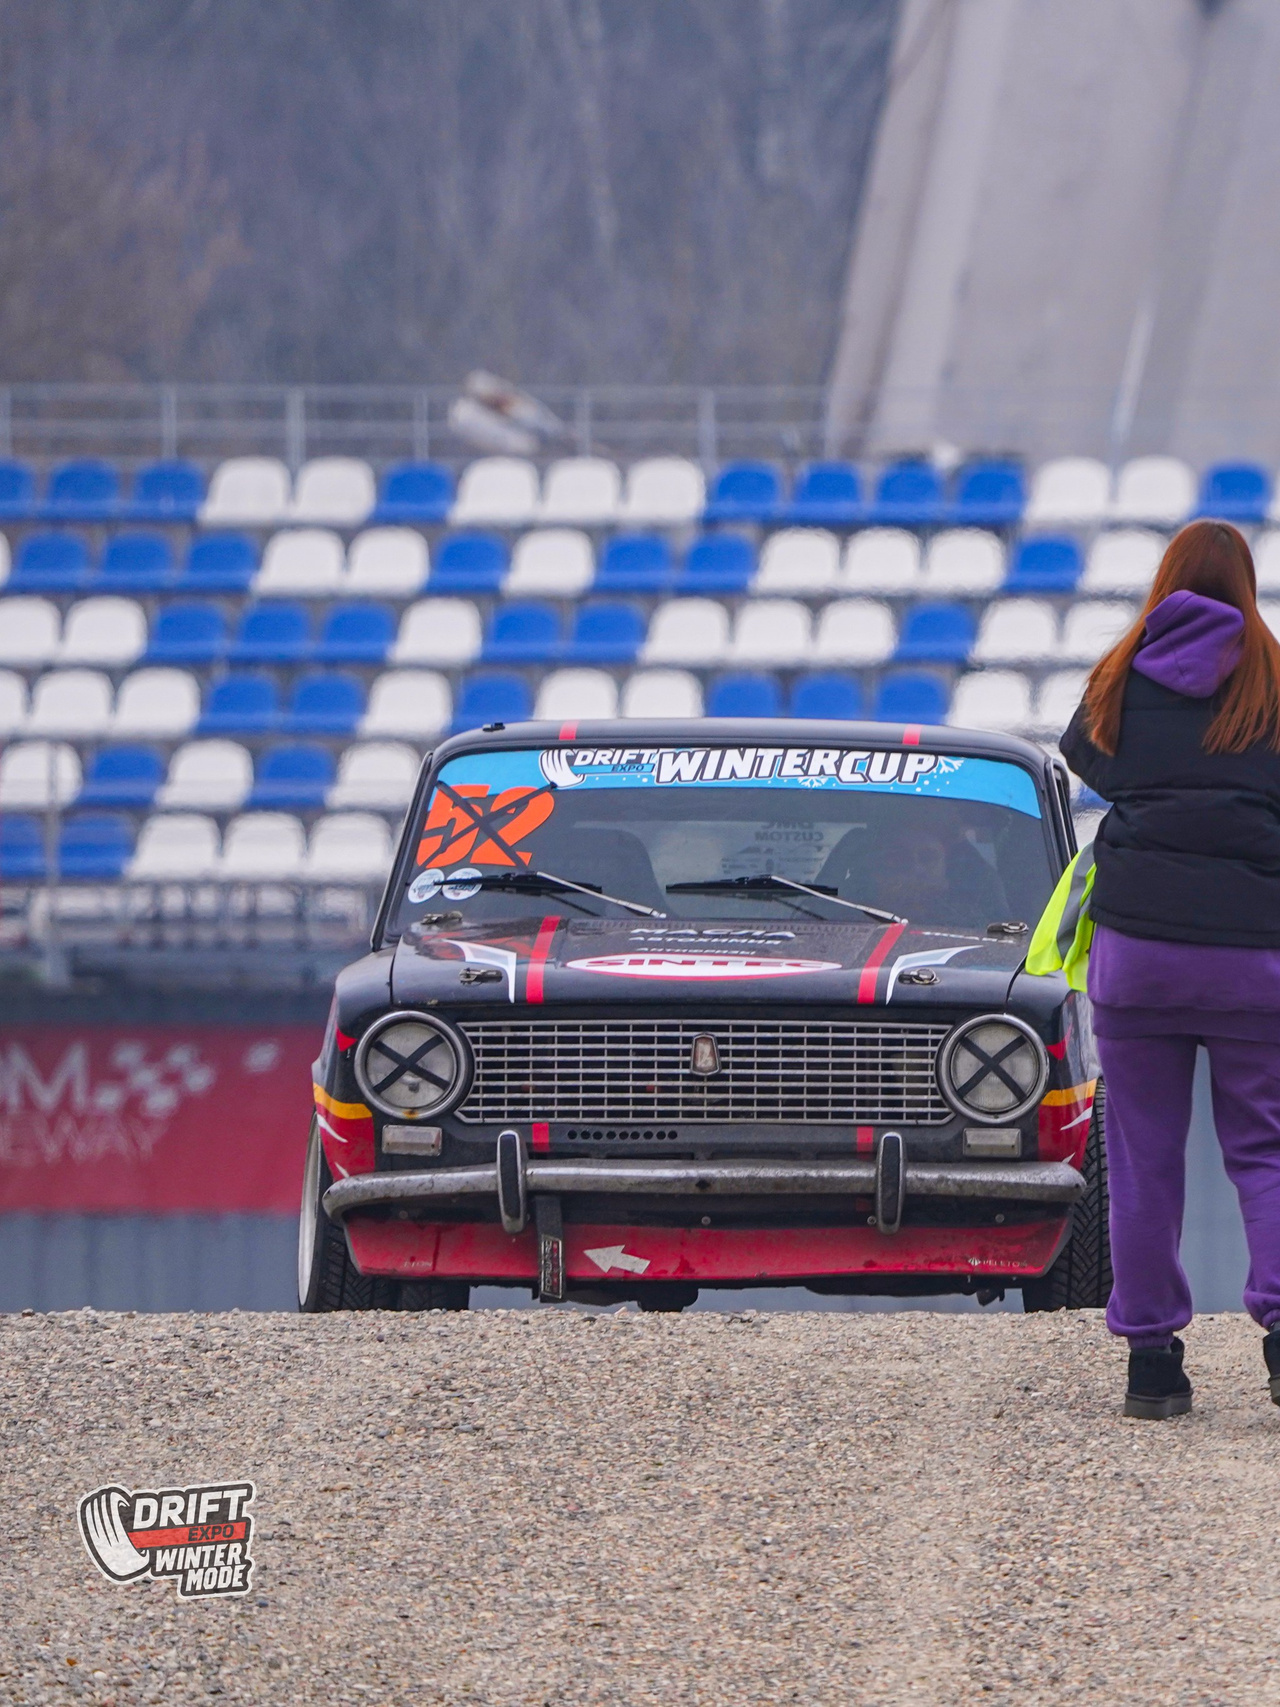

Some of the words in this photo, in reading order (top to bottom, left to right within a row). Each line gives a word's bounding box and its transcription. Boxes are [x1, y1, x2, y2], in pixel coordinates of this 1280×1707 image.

[573, 749, 657, 767] DRIFT
[610, 763, 645, 773] EXPO
[416, 784, 555, 869] 52
[630, 928, 796, 939] МАСЛА
[586, 958, 824, 969] SINTEC
[0, 1040, 88, 1116] M
